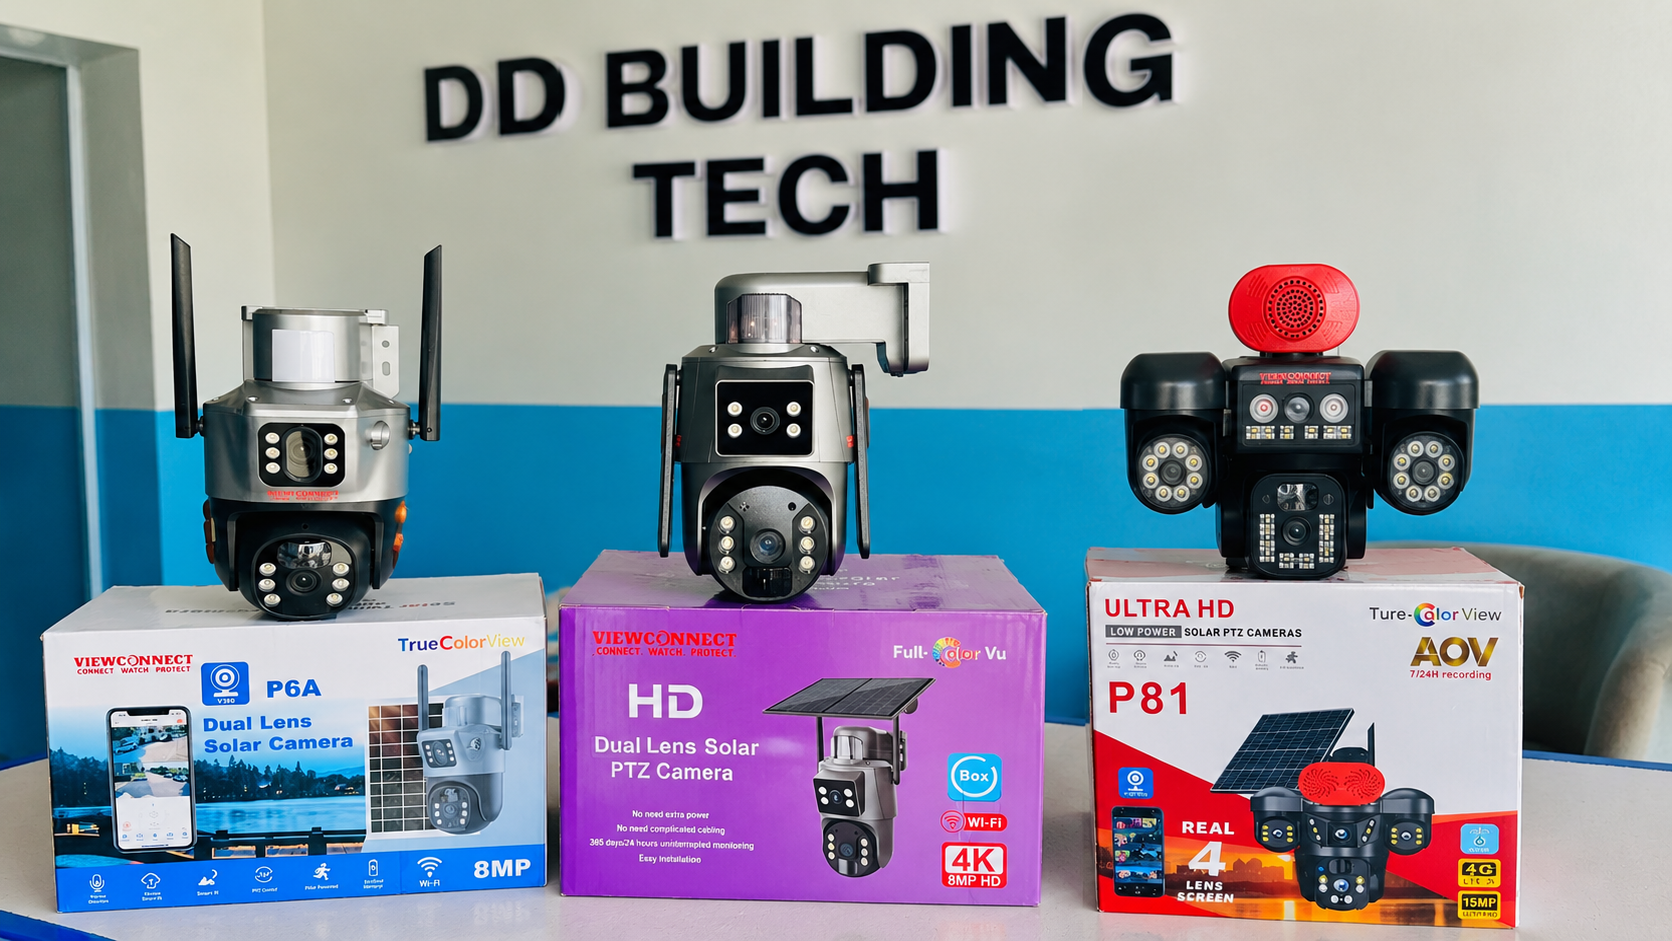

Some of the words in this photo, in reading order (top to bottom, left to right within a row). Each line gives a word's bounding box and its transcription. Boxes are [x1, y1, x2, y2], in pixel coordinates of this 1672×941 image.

[424, 57, 566, 142] DD
[606, 13, 1175, 129] BUILDING
[632, 149, 940, 238] TECH
[1105, 598, 1190, 618] ULTRA
[1198, 599, 1235, 618] HD
[1462, 608, 1502, 621] View
[592, 630, 738, 647] VIEWCONNECT
[1110, 627, 1135, 637] LOW
[1137, 628, 1176, 637] POWER
[1184, 628, 1221, 638] SOLAR
[1223, 628, 1244, 638] PTZ
[1247, 628, 1303, 639] CAMERAS
[397, 634, 526, 653] TrueColorView
[690, 648, 737, 658] PROTECT.
[985, 646, 1007, 660] Vu
[1410, 636, 1499, 667] AOV
[74, 654, 194, 667] VIEWCONNECT
[77, 667, 114, 675] CONNECT
[155, 665, 191, 673] PROTECT
[1410, 670, 1439, 679] 7/24H
[1442, 670, 1492, 681] recording
[267, 679, 322, 698] P6A
[628, 683, 703, 719] HD
[1109, 681, 1188, 715] P81
[203, 716, 252, 732] Dual
[260, 715, 312, 730] Lens
[204, 738, 261, 753] Solar
[269, 733, 353, 751] Camera
[595, 736, 641, 755] Dual
[647, 737, 697, 756] Lens
[704, 738, 759, 757] Solar
[611, 762, 651, 779] PTZ
[656, 763, 733, 782] Camera
[960, 769, 989, 782] Box
[632, 810, 643, 818] No
[645, 810, 664, 818] need
[616, 824, 628, 832] No
[1182, 821, 1235, 835] REAL
[952, 847, 996, 873] 4K
[1188, 841, 1226, 877] 4
[474, 858, 531, 878] 8MP
[1465, 863, 1494, 876] 4G
[947, 874, 977, 886] 8MP
[980, 875, 1001, 887] HD
[1186, 880, 1223, 891] LENS
[1177, 892, 1234, 903] SCREEN
[1463, 897, 1497, 908] 15MP
